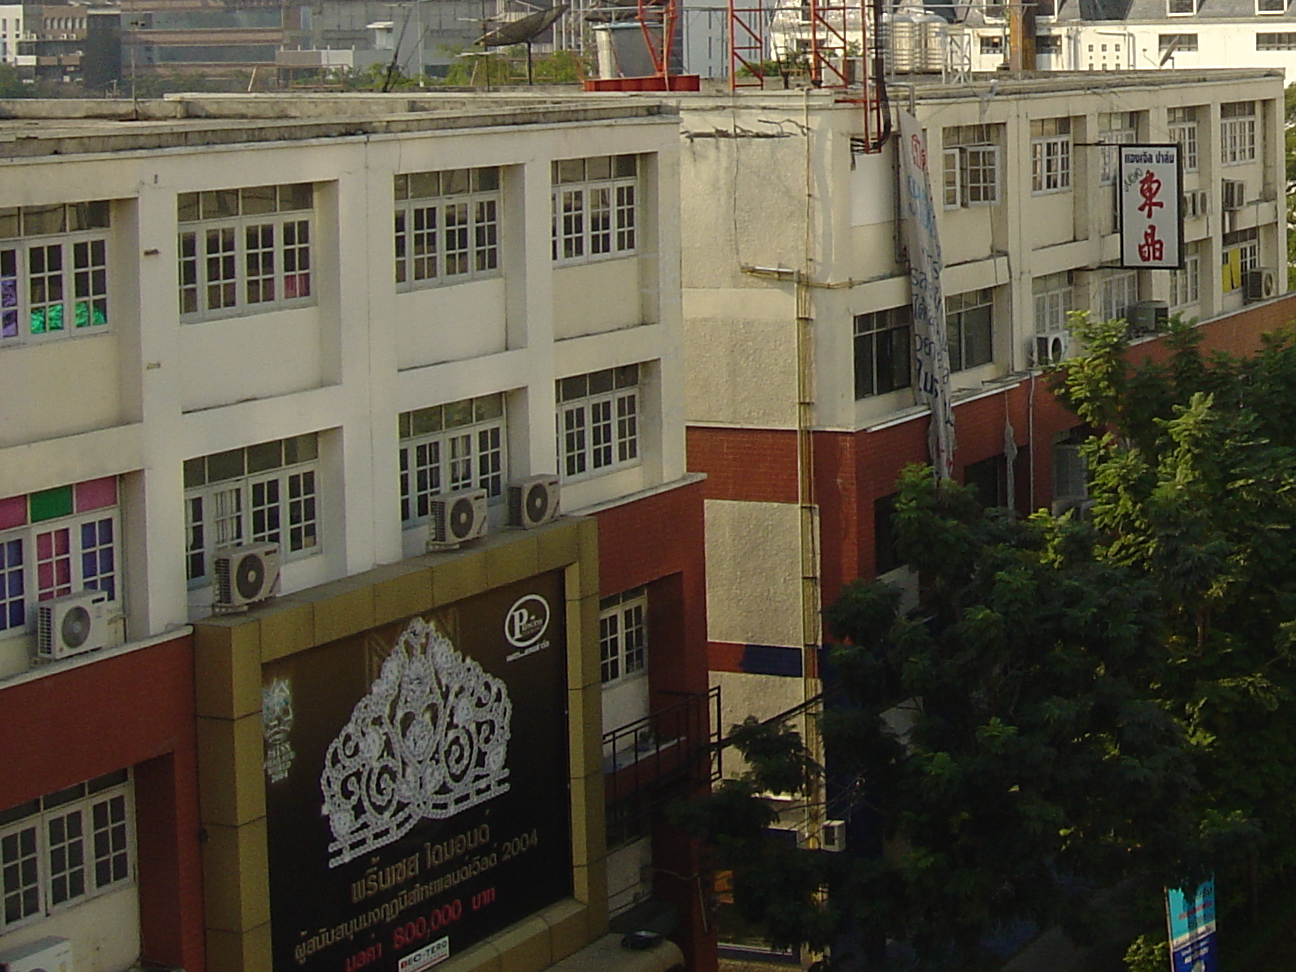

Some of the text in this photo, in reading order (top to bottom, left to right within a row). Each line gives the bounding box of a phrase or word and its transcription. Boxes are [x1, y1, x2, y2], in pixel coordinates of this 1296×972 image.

[501, 828, 538, 862] 2004
[392, 899, 463, 950] 800,000
[471, 887, 496, 911] บาท
